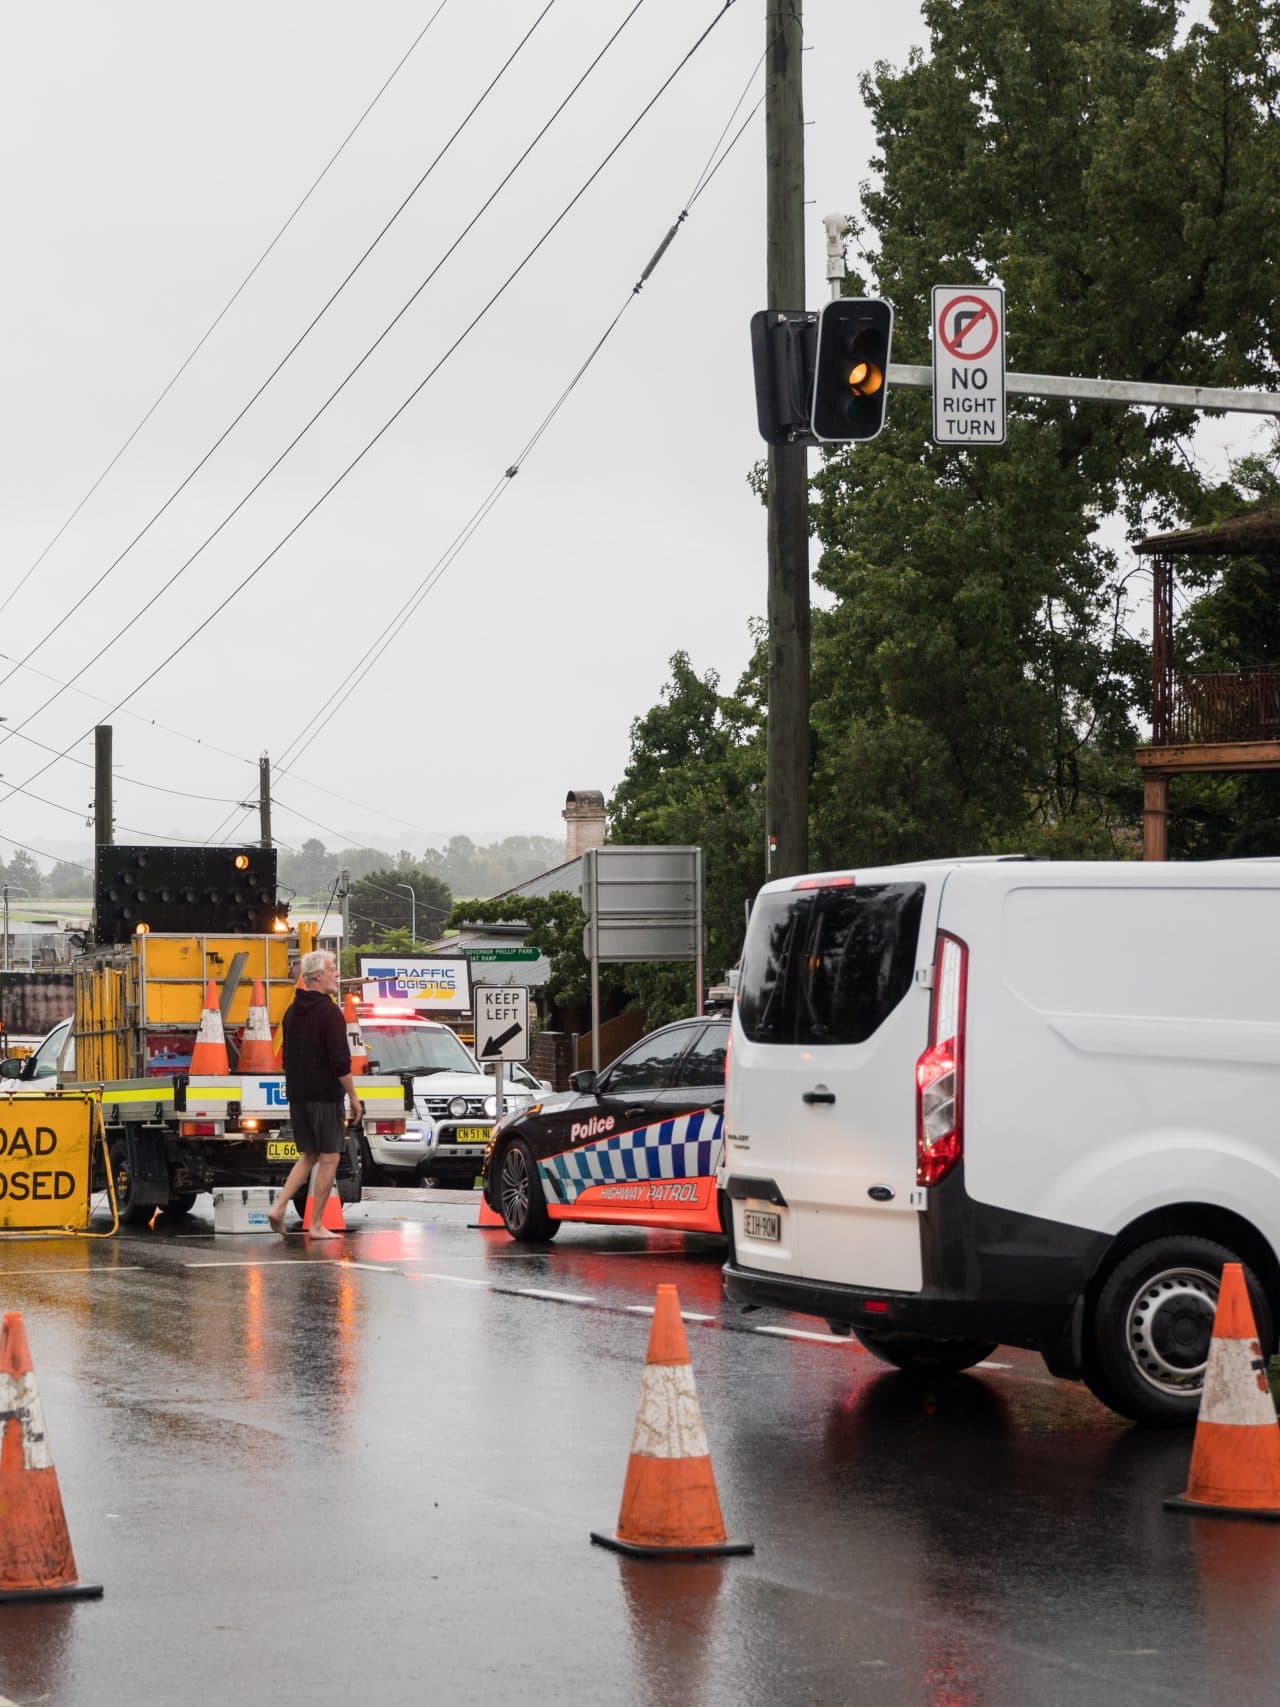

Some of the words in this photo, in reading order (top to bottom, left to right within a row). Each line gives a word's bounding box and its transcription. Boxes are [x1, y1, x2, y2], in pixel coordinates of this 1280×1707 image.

[952, 367, 988, 390] NO
[943, 397, 997, 413] RIGHT
[946, 419, 995, 435] TURN
[485, 993, 520, 1005] KEEP
[487, 1008, 519, 1020] LEFT
[571, 1115, 616, 1142] Police
[600, 1185, 645, 1201] HIGHWAY
[646, 1183, 699, 1202] PATROL
